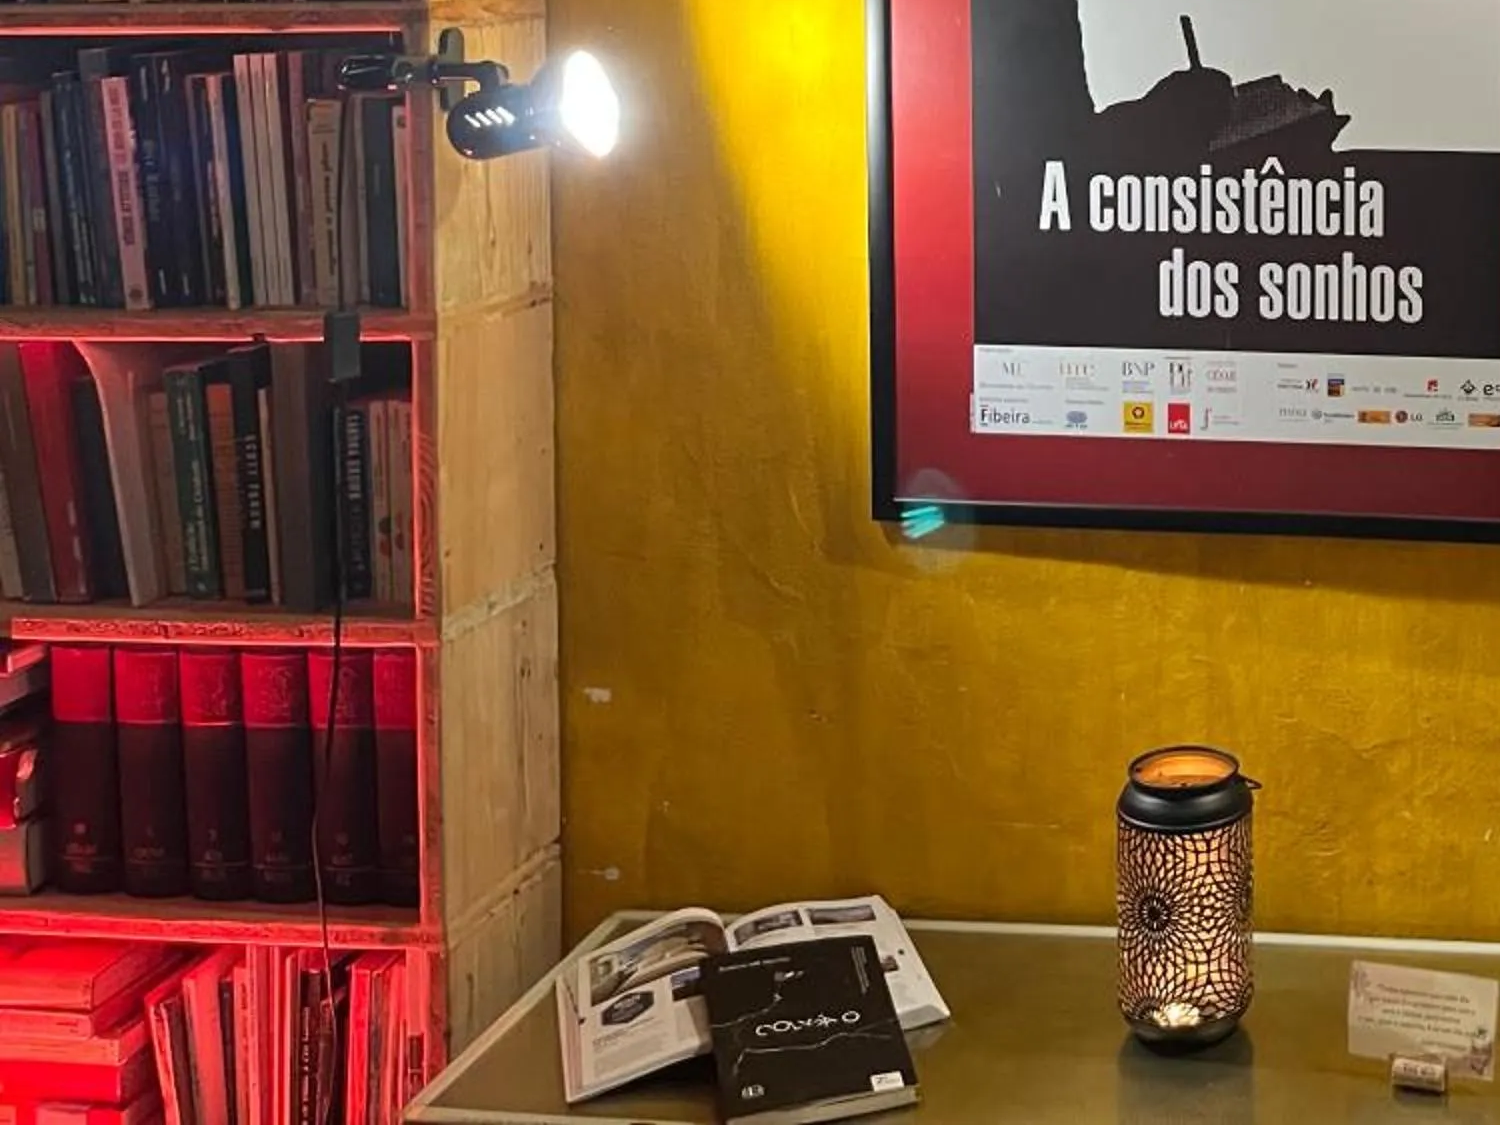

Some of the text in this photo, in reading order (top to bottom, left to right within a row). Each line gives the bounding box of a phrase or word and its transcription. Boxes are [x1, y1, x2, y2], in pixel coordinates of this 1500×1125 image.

[1038, 155, 1386, 239] A consistência
[1157, 247, 1424, 325] dos sonhos
